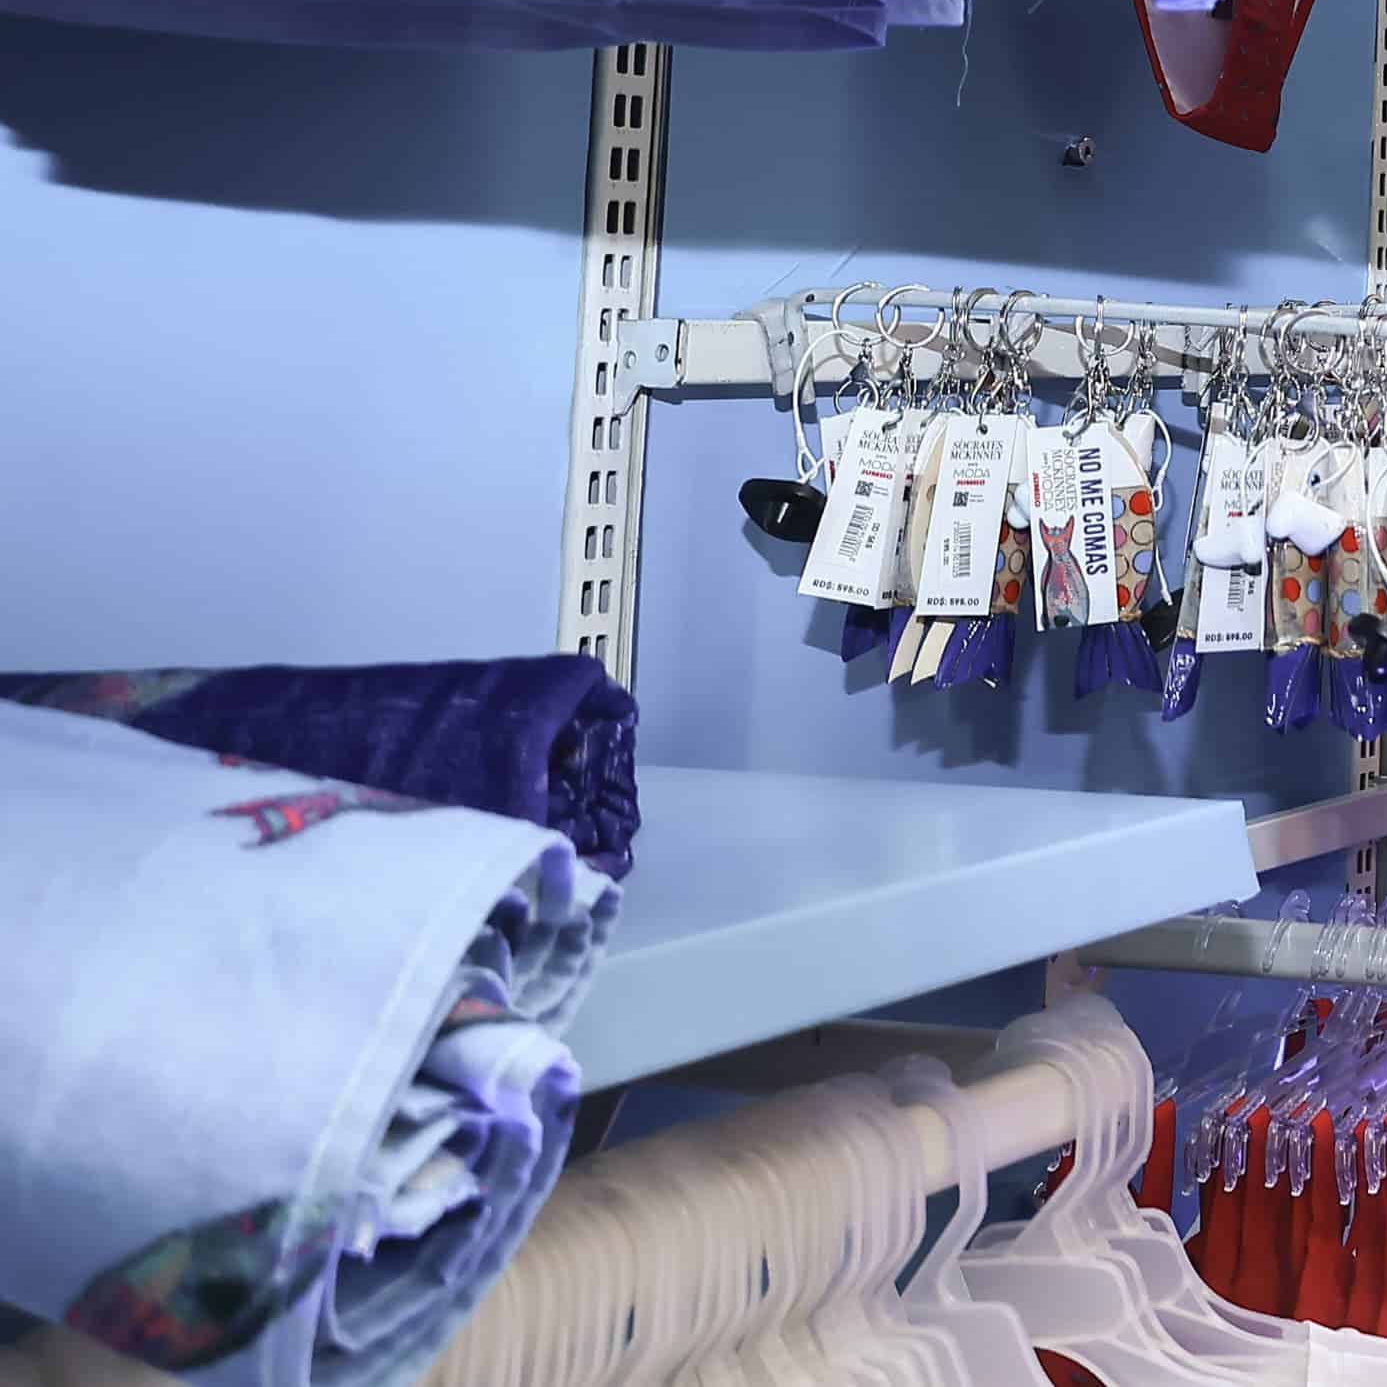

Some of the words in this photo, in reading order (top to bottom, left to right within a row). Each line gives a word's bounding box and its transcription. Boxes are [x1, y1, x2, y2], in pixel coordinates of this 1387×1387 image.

[953, 468, 990, 479] MODA
[1078, 447, 1101, 473] NO
[1041, 464, 1054, 511] MODA
[1080, 478, 1104, 507] ME
[1082, 512, 1108, 576] COMAS
